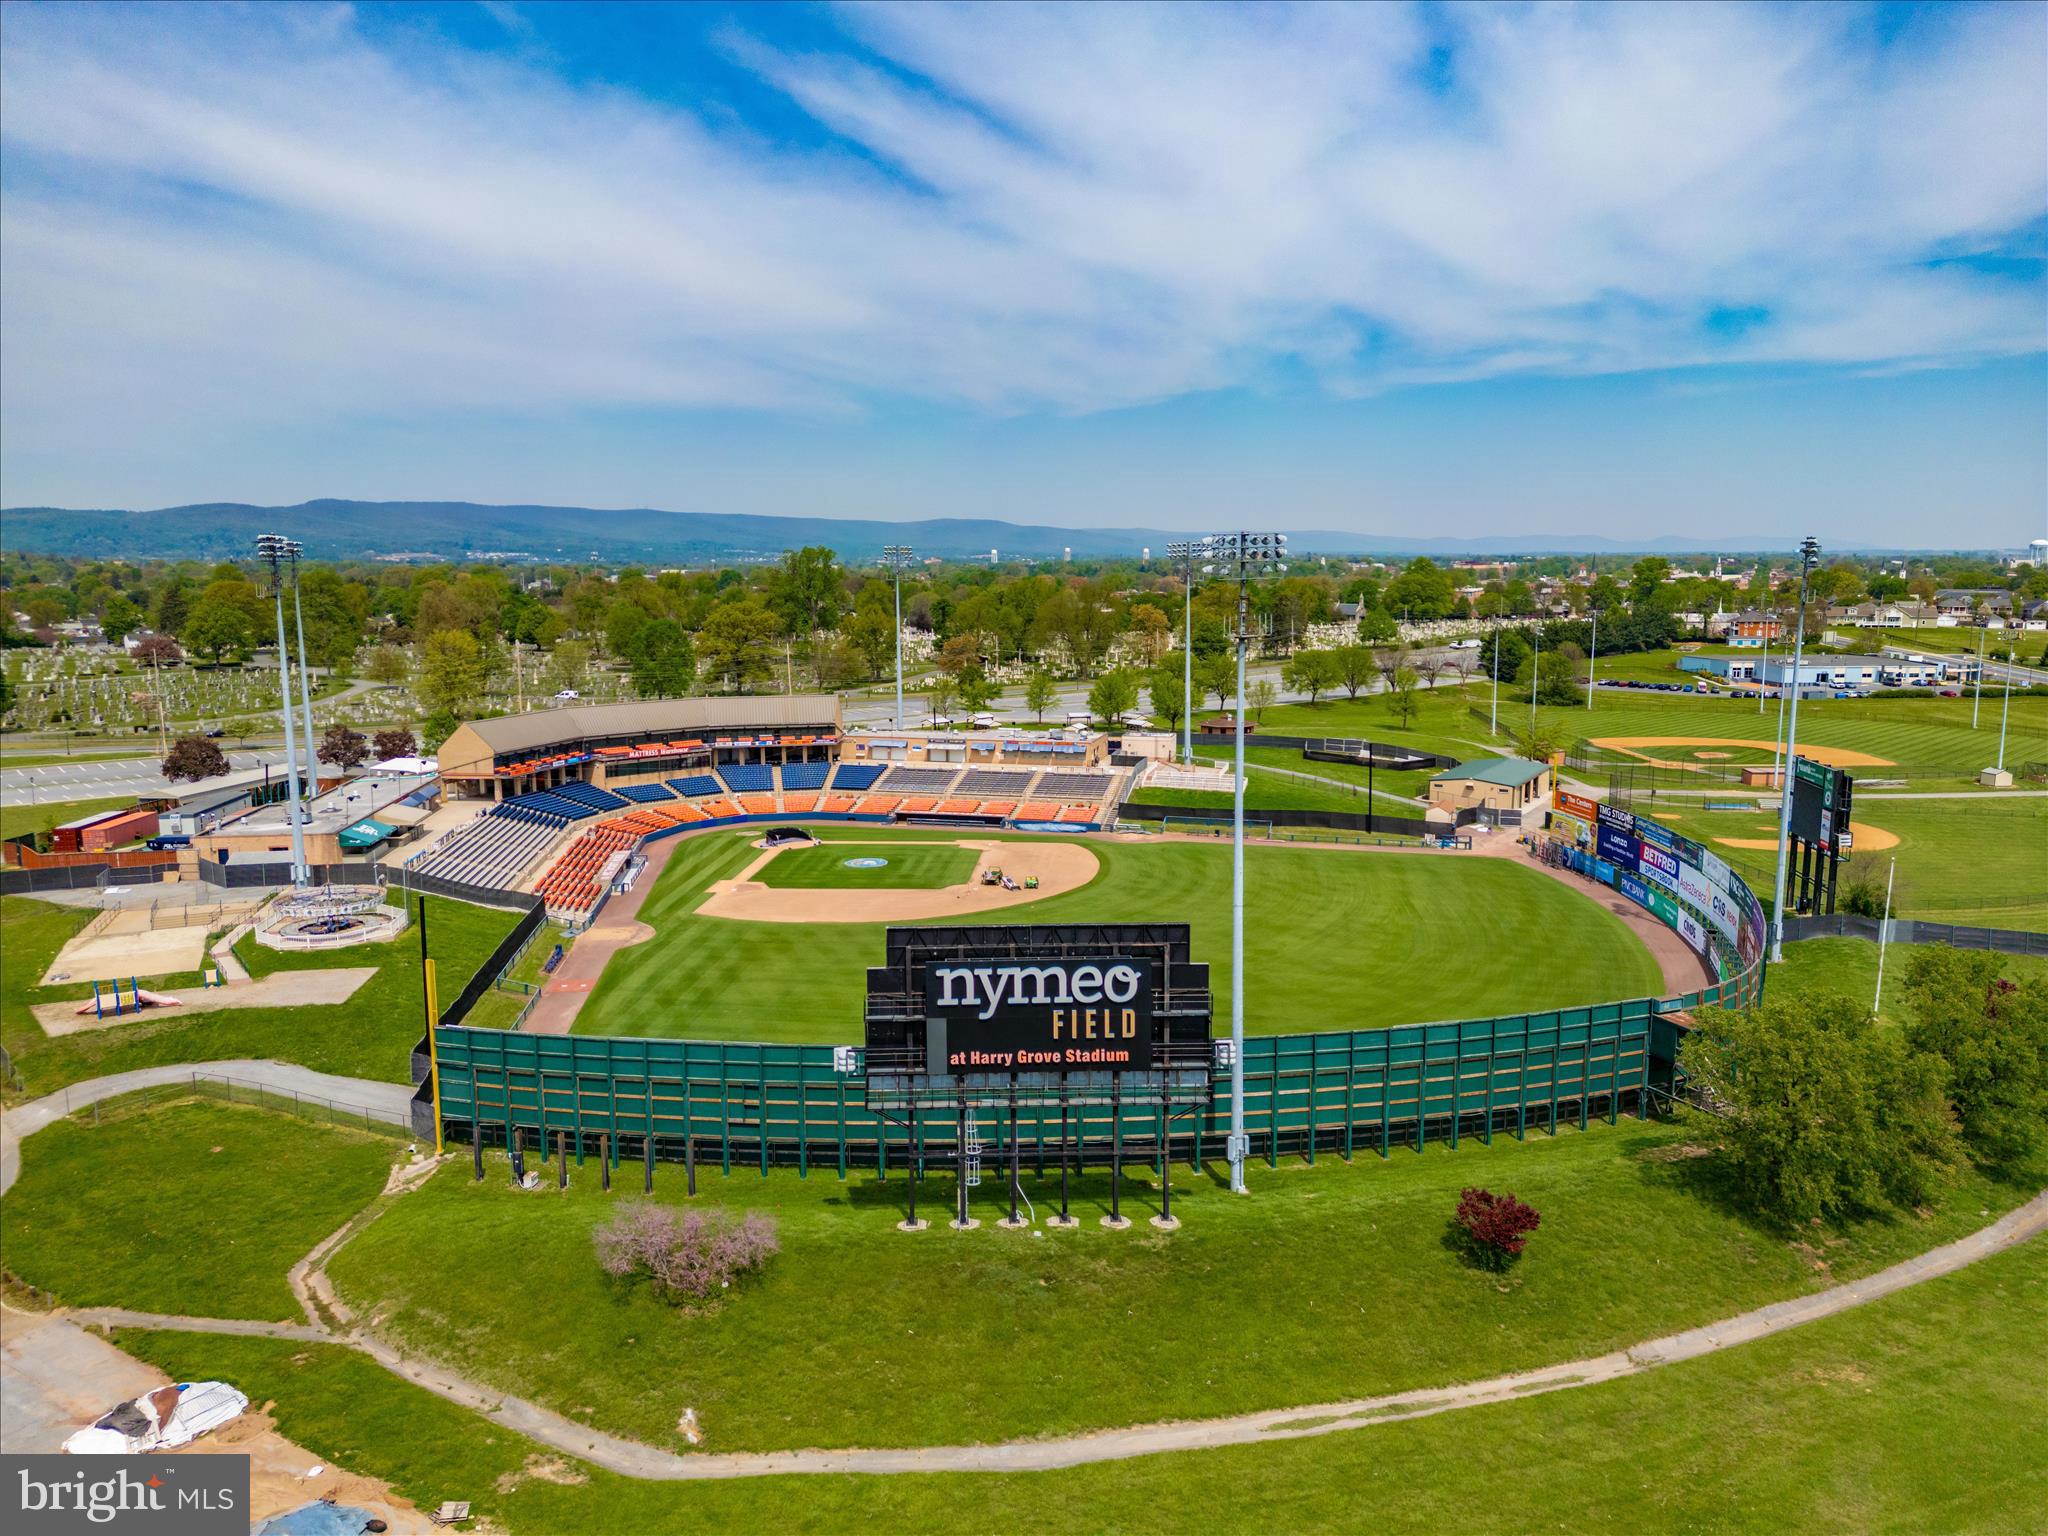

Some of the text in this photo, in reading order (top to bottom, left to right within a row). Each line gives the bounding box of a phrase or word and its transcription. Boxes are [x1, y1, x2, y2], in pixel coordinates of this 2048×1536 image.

[629, 750, 659, 758] MATTRESS
[1599, 805, 1612, 817] TMG
[1644, 846, 1676, 873] BETFRED
[1644, 866, 1674, 886] SPORTSBOOK
[935, 964, 1142, 1020] nymeo
[1053, 1008, 1136, 1040] FIELD
[950, 1048, 1129, 1066] at Harry Grove Stadium
